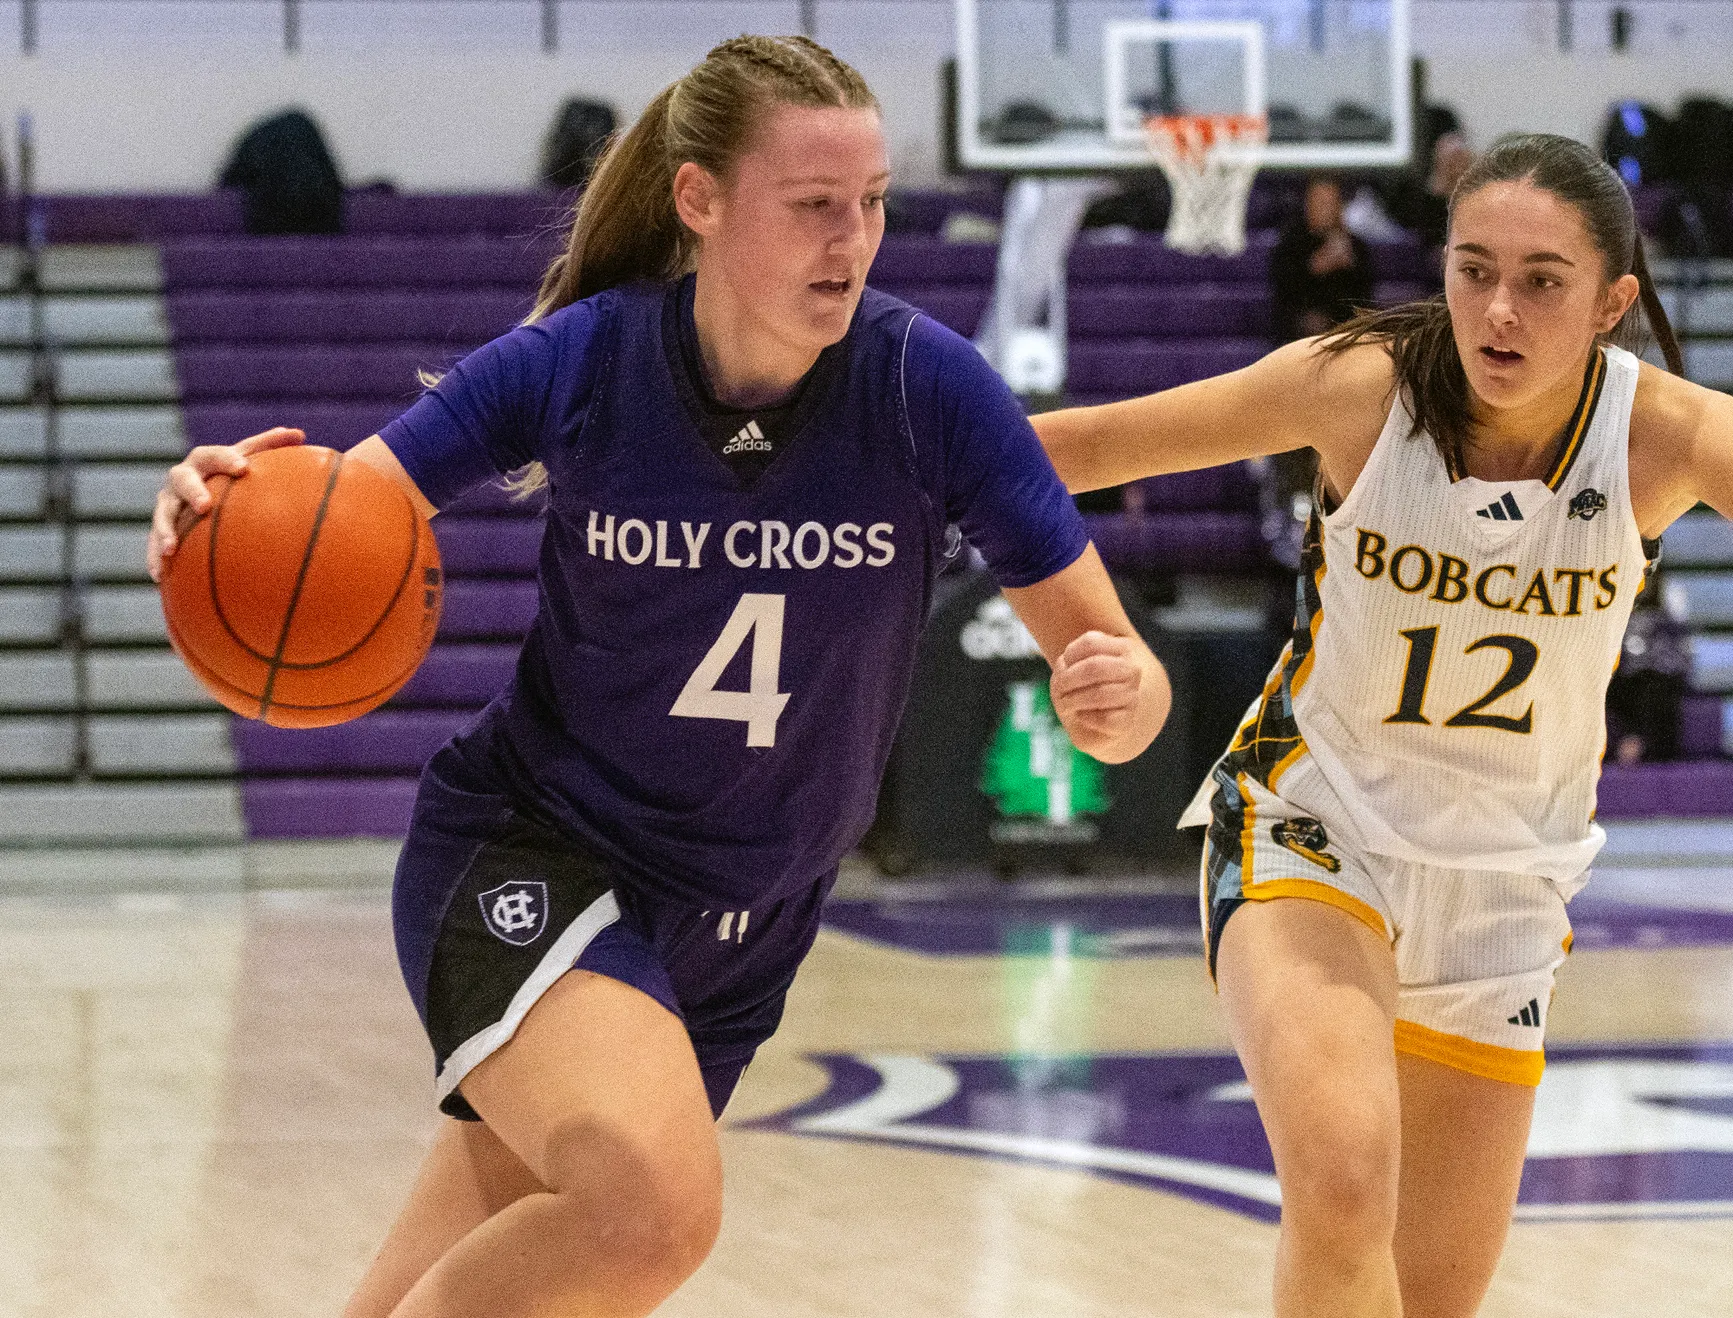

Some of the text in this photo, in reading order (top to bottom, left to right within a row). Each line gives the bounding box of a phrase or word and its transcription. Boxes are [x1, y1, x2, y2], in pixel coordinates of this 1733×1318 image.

[723, 439, 772, 454] adidas
[586, 510, 896, 570] HOLY CROSS
[1354, 527, 1620, 617] BOBCATS
[668, 592, 792, 748] 4
[1382, 624, 1541, 735] 12
